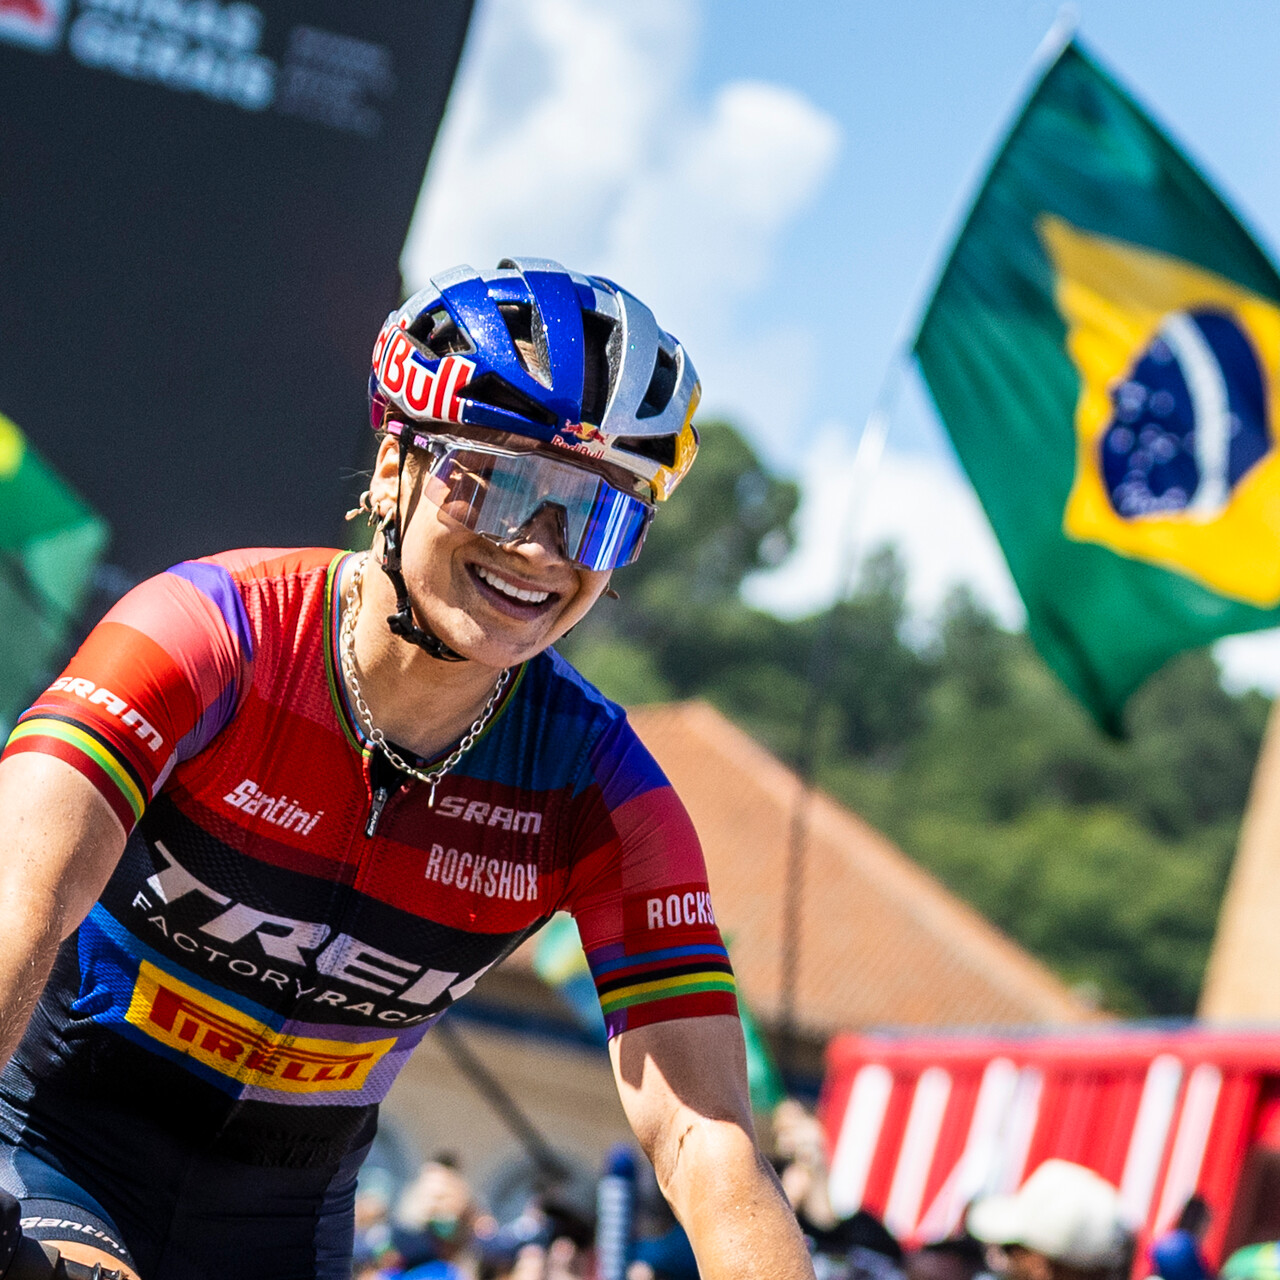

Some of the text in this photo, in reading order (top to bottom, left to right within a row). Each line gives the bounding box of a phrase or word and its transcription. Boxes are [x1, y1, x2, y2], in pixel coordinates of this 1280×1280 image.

[382, 332, 471, 422] Bull
[46, 676, 164, 752] SRAM
[222, 778, 324, 836] Santini
[435, 796, 542, 834] SRAM
[424, 843, 538, 902] ROCKSHOX
[132, 890, 317, 1000] FACTORY
[149, 984, 374, 1083] PIRELLI
